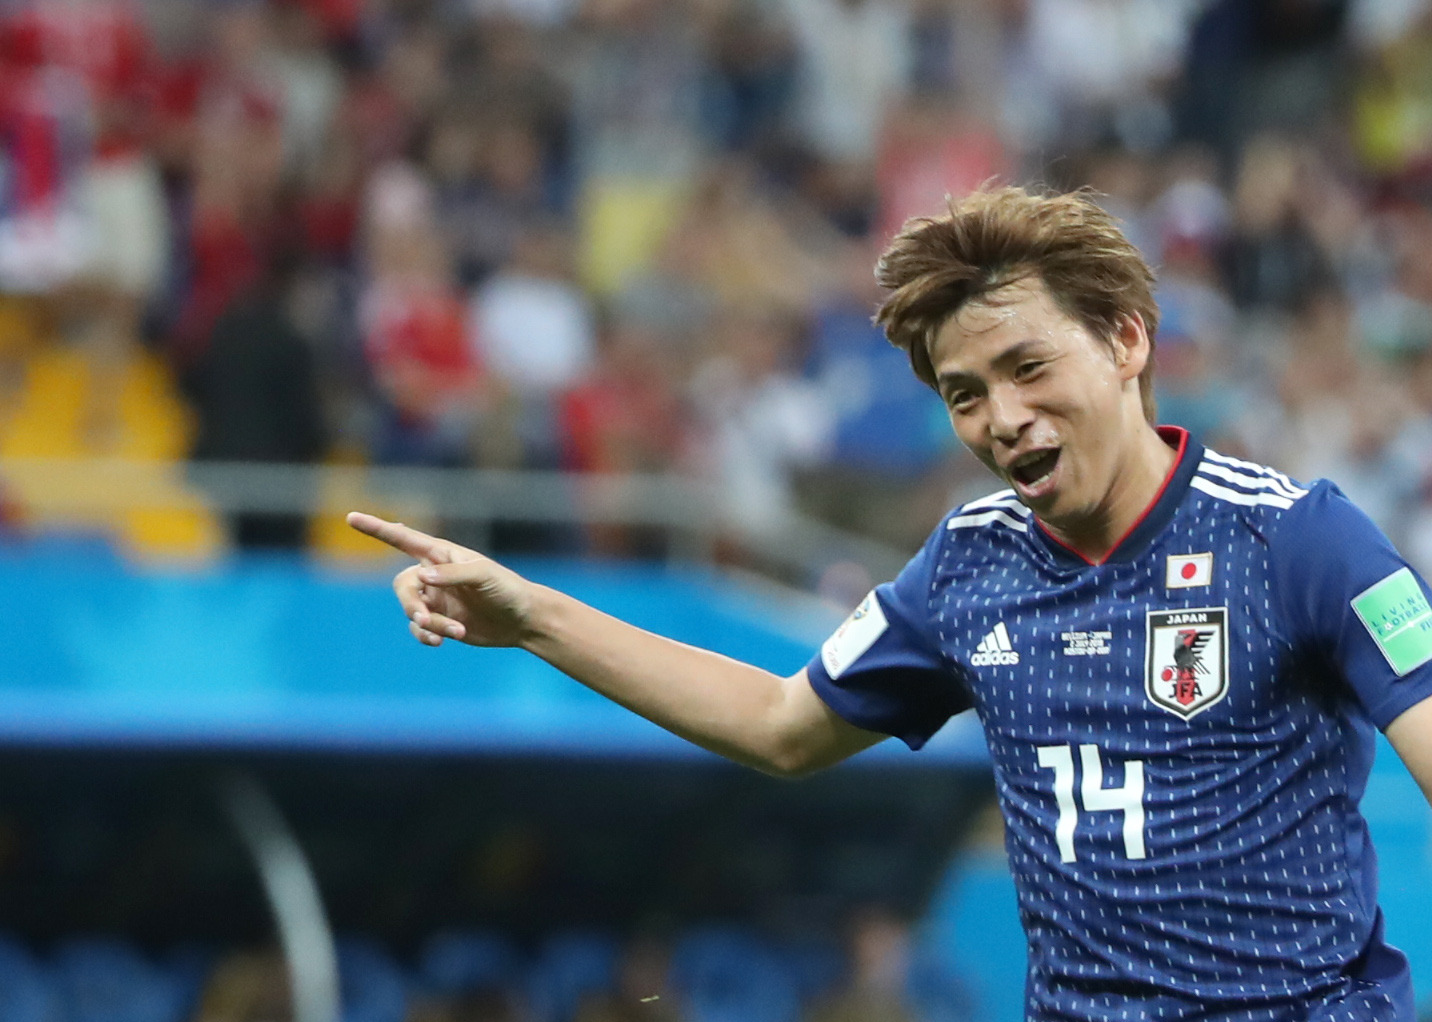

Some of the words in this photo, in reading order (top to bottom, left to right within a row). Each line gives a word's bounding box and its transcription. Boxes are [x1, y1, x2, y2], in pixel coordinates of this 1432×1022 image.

[1166, 613, 1208, 625] JAPAN
[970, 650, 1020, 667] adidas
[1168, 682, 1203, 699] JFA
[1036, 743, 1147, 864] 14
